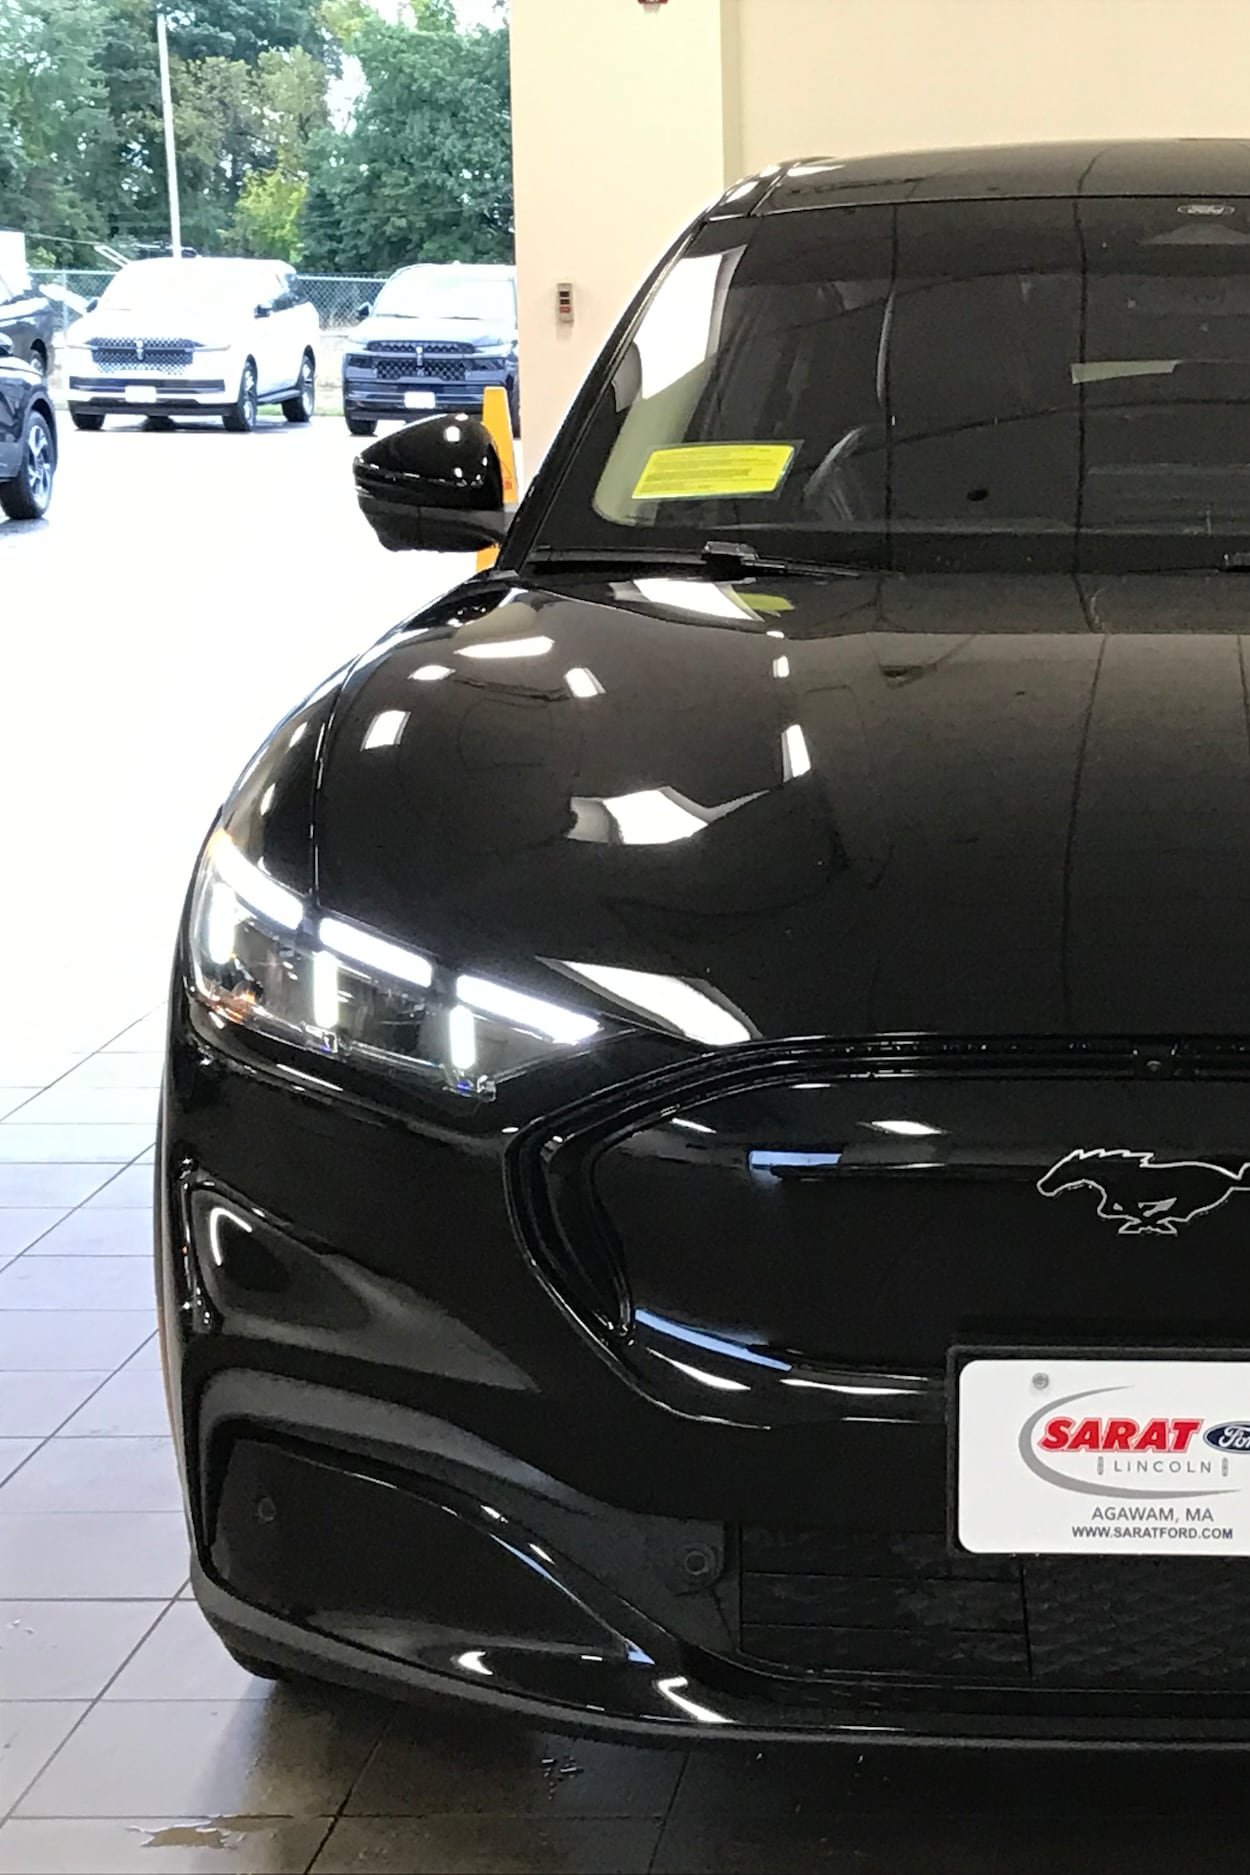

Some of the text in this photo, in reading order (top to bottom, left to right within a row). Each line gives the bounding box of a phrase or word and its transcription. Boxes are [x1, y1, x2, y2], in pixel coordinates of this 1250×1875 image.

[1038, 1417, 1203, 1452] SARAT
[1113, 1460, 1212, 1474] LINCOLN
[1091, 1506, 1214, 1523] AGAWAM, MA
[1071, 1525, 1233, 1540] WWW.SARATFORD.COM
